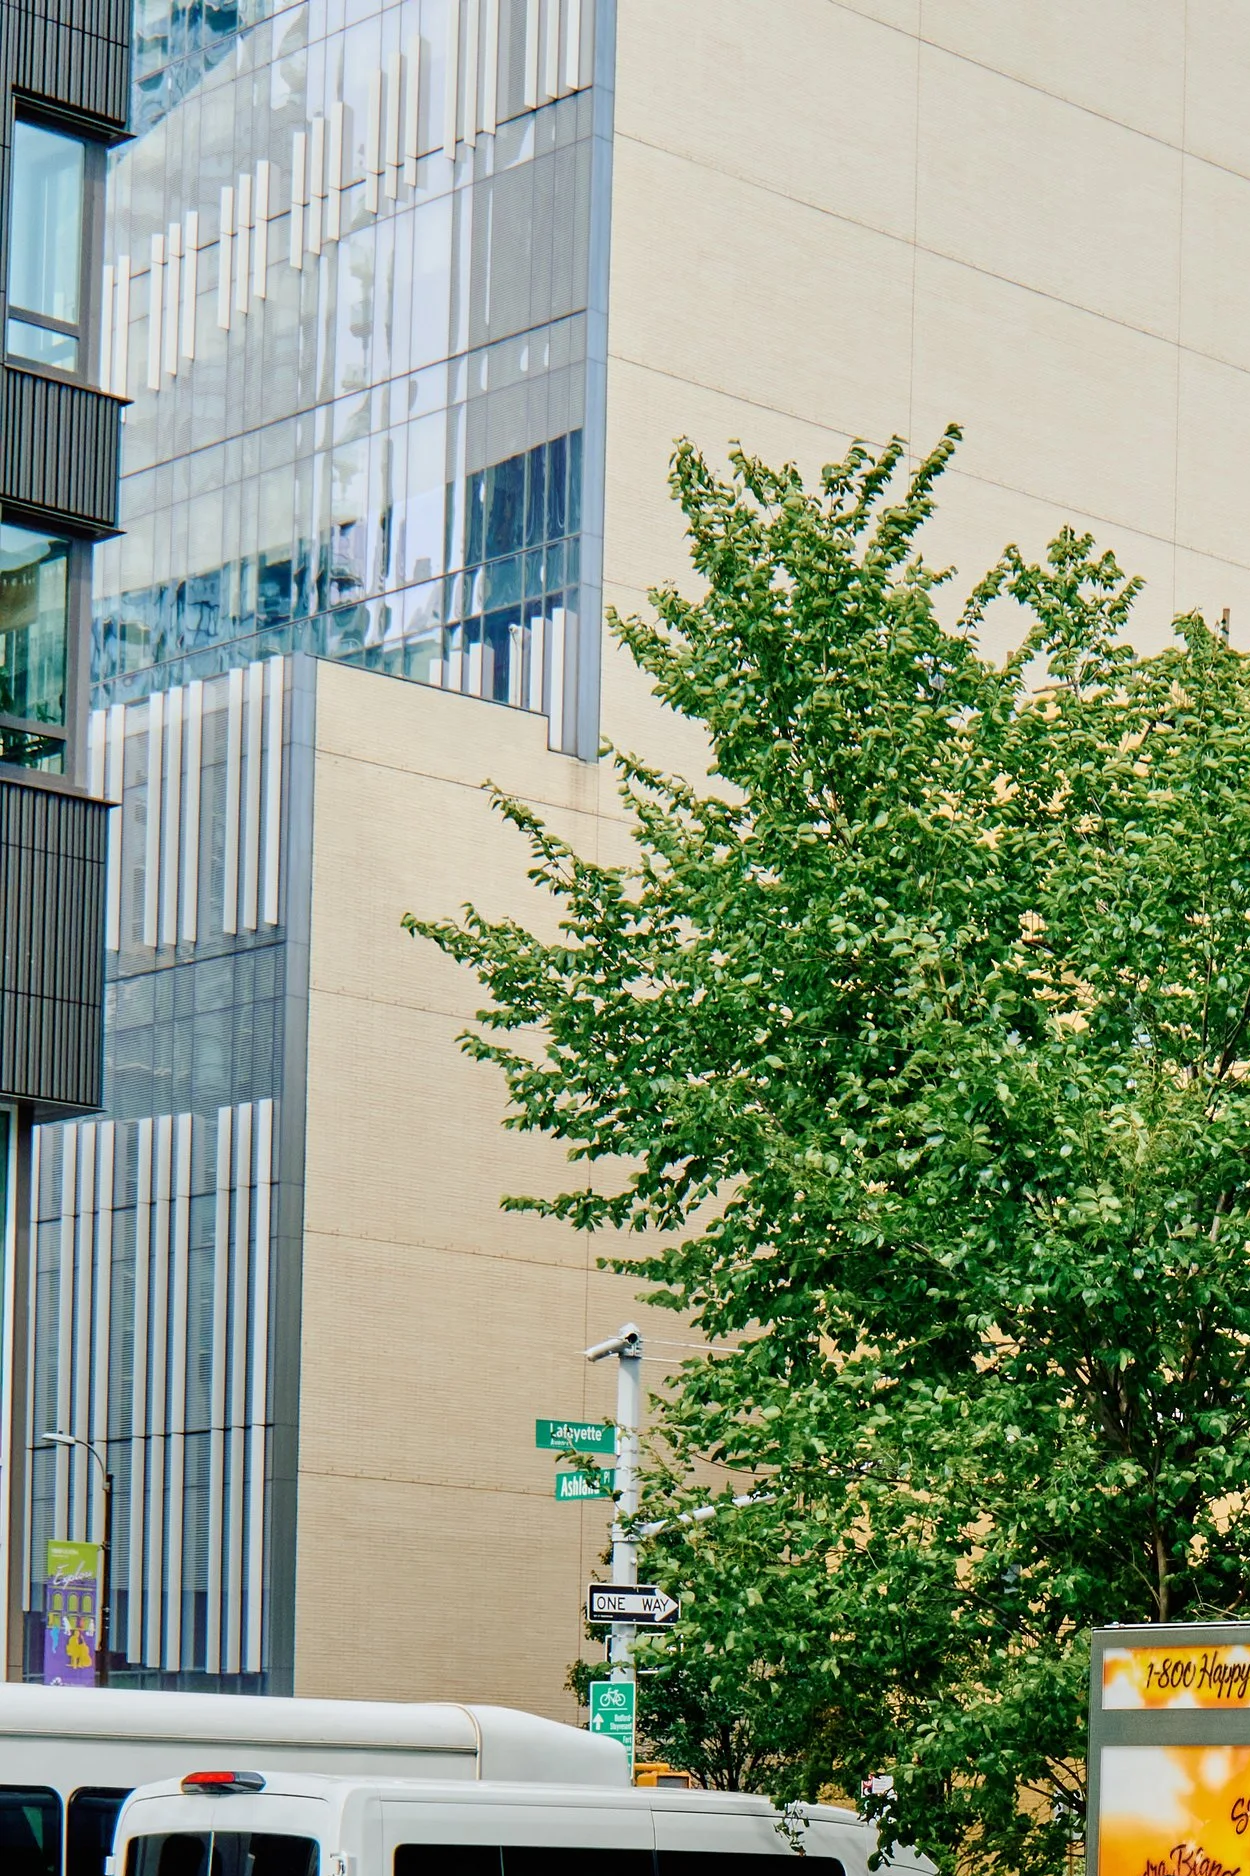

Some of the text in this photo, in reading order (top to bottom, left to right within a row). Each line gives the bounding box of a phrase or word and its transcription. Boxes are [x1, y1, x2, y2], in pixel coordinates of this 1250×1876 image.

[550, 1422, 602, 1443] Lafayette
[603, 1471, 611, 1484] Pl
[597, 1596, 669, 1612] ONE WAY
[1146, 1658, 1196, 1688] 1-800
[1198, 1651, 1250, 1698] Happy
